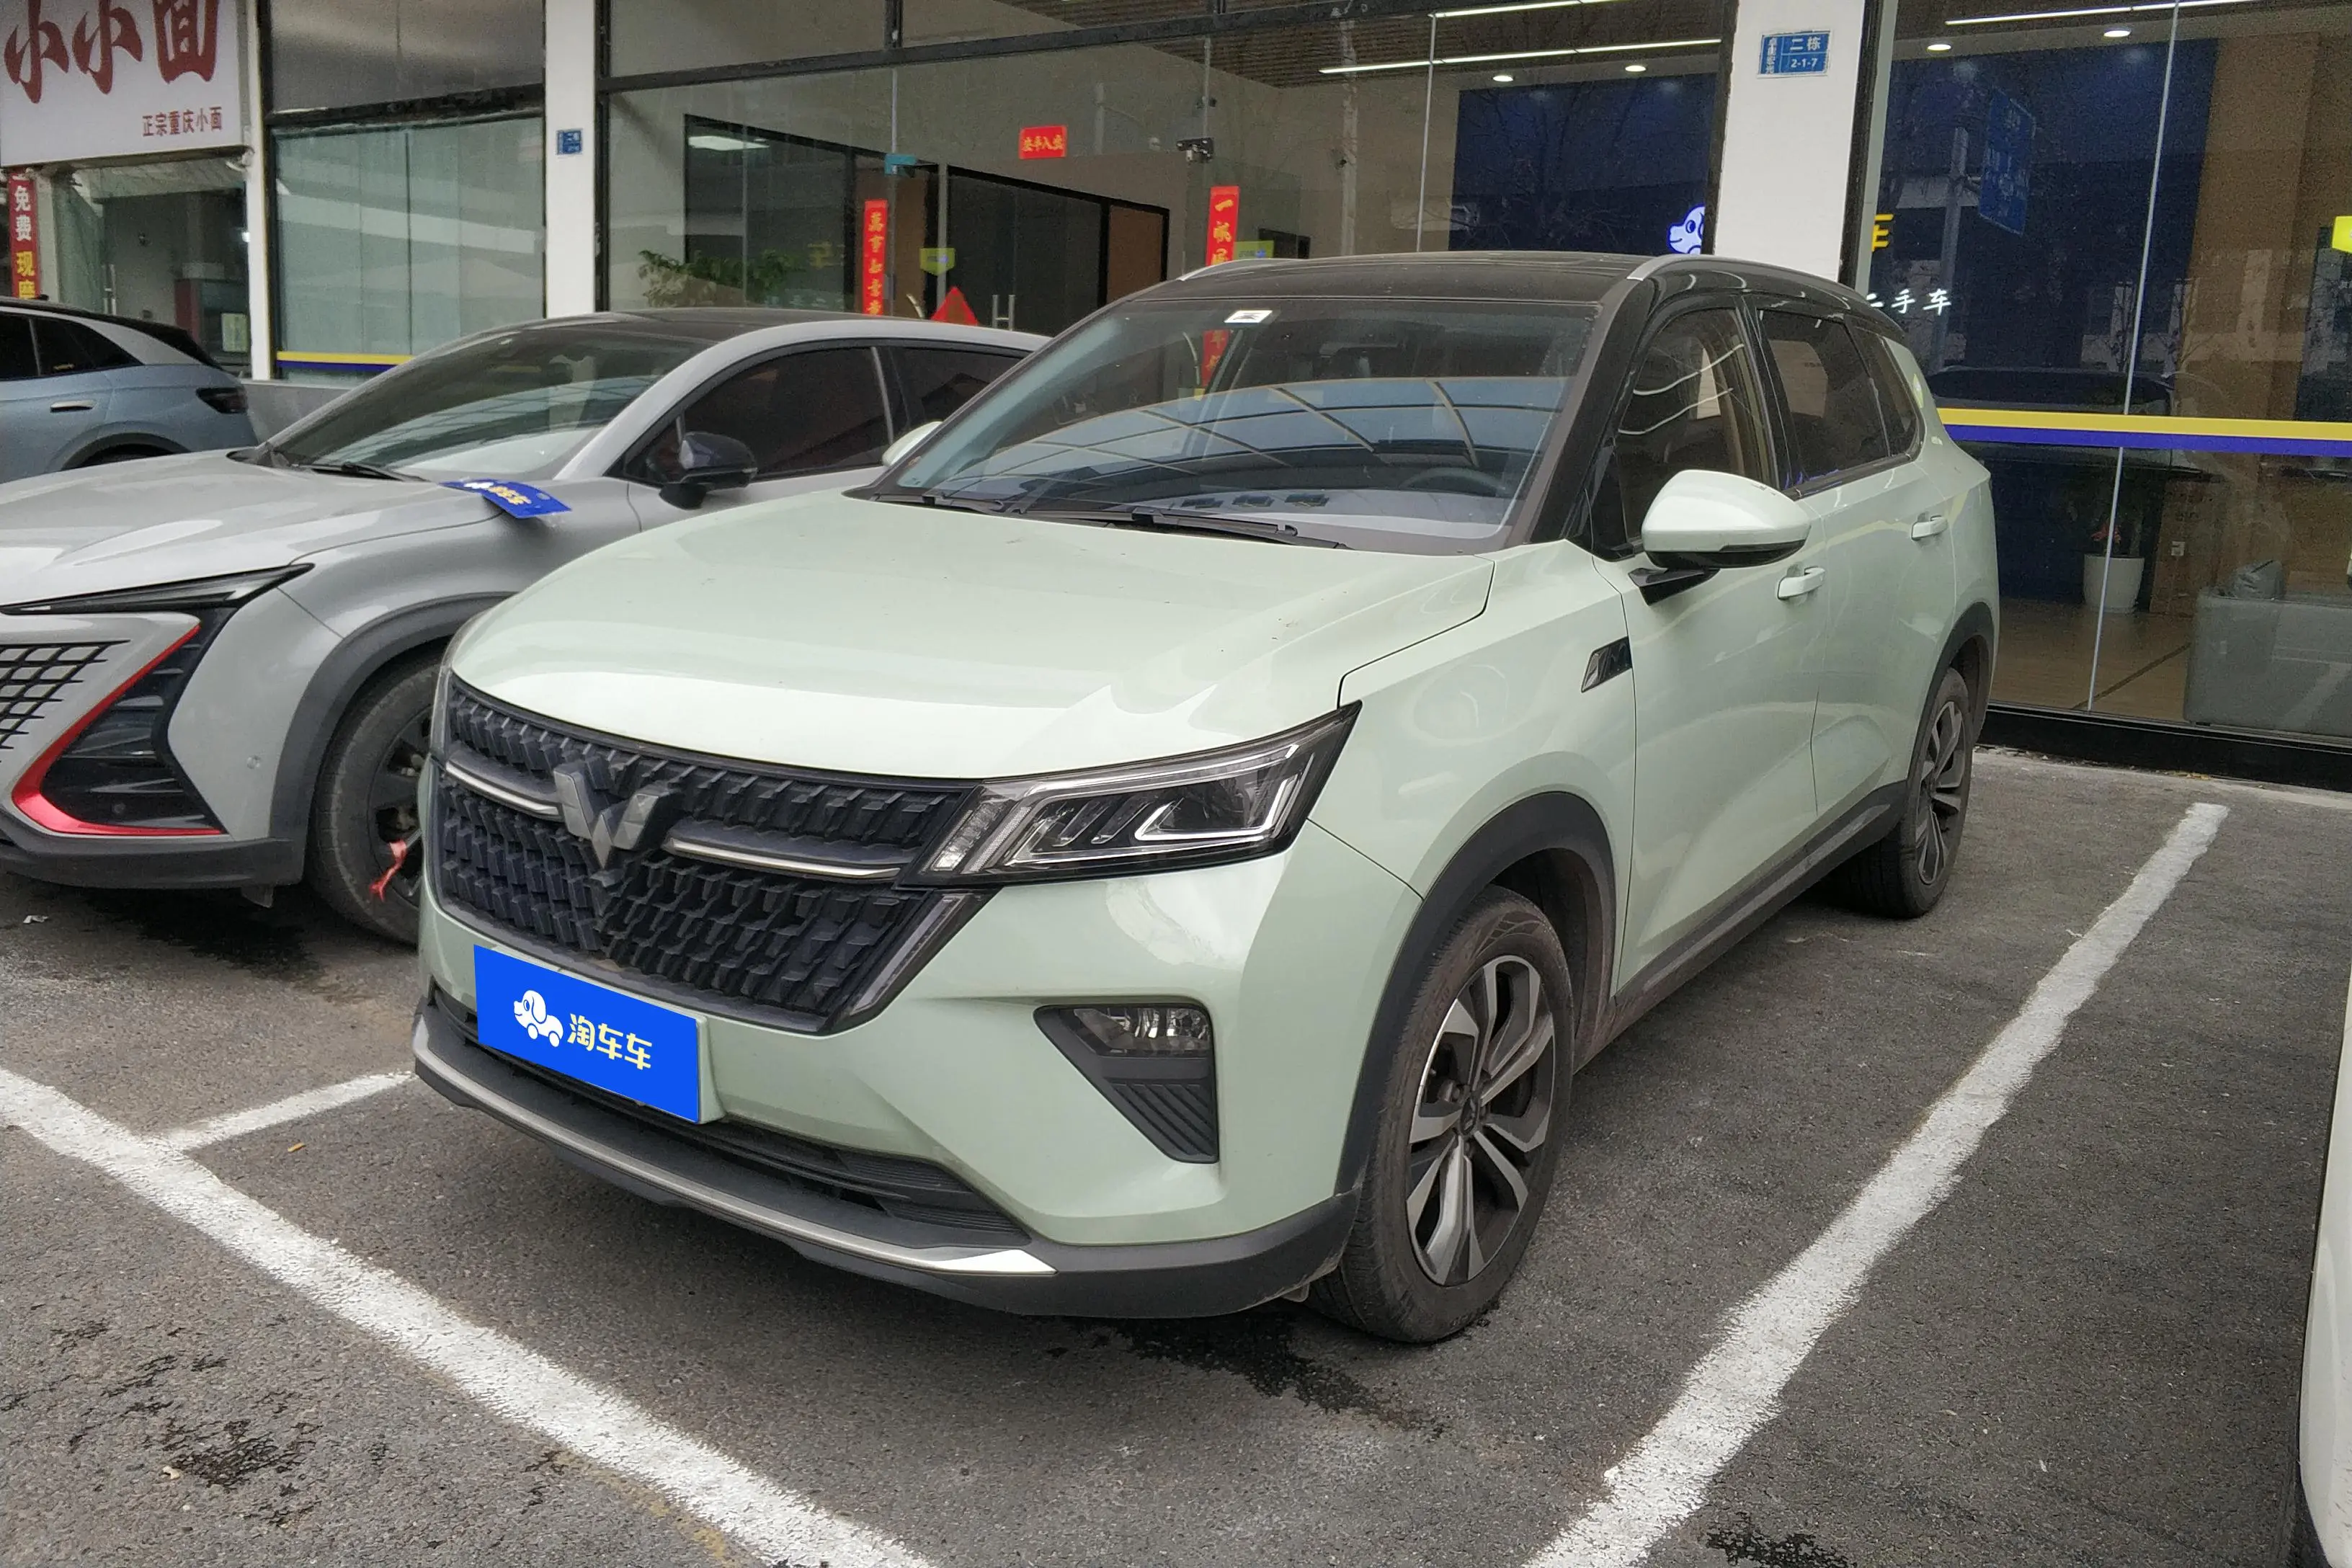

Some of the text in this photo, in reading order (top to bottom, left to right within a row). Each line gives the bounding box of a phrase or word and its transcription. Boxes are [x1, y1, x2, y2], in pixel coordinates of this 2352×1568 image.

[1790, 36, 1821, 51] 二栋
[1791, 58, 1818, 68] 2-1-7
[142, 107, 223, 137] 正宗重庆小面
[1866, 288, 1951, 316] 二手车
